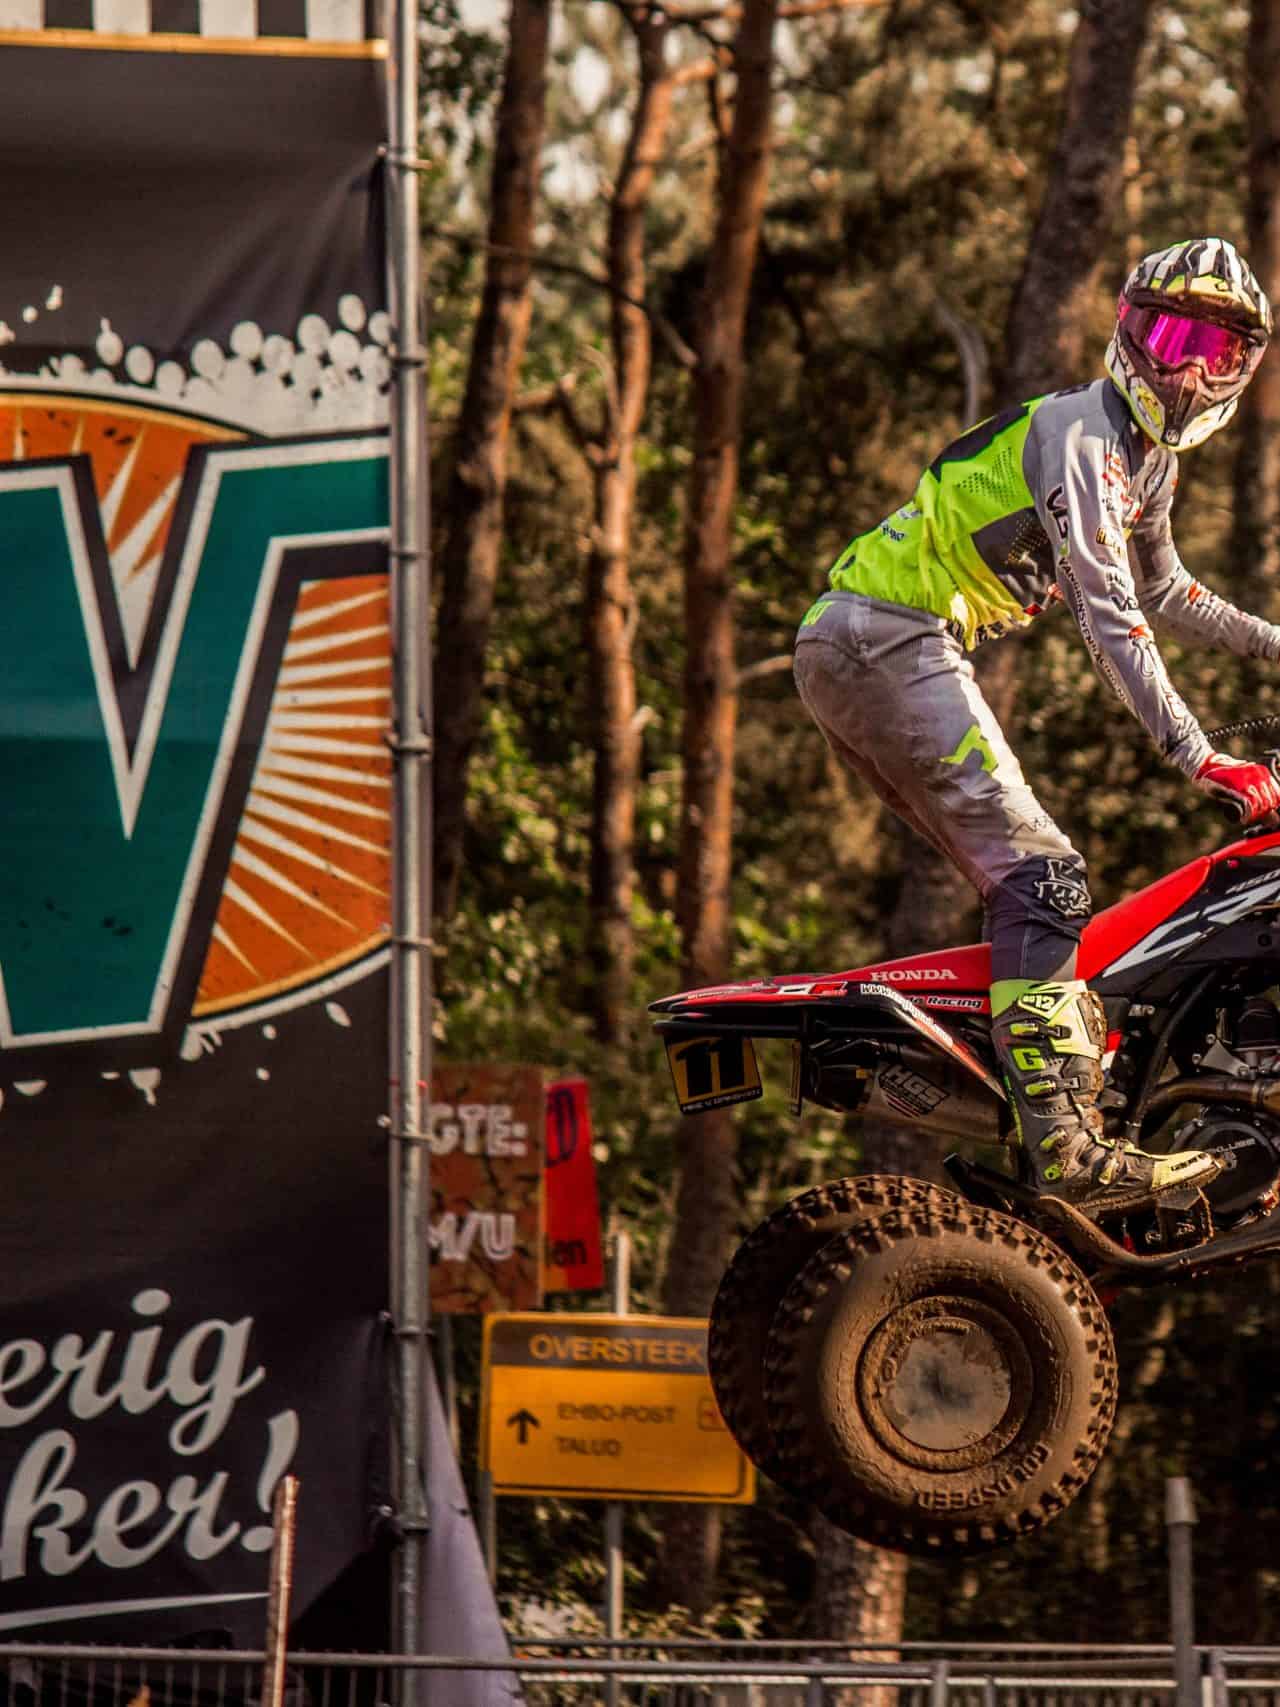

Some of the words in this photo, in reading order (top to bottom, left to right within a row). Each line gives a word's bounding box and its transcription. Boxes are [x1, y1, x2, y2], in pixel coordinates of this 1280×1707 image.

[869, 968, 959, 982] HONDA
[926, 996, 984, 1009] Racing
[528, 1332, 705, 1366] OVERSTEEK
[0, 1288, 266, 1456] erig
[556, 1436, 622, 1457] TALUD
